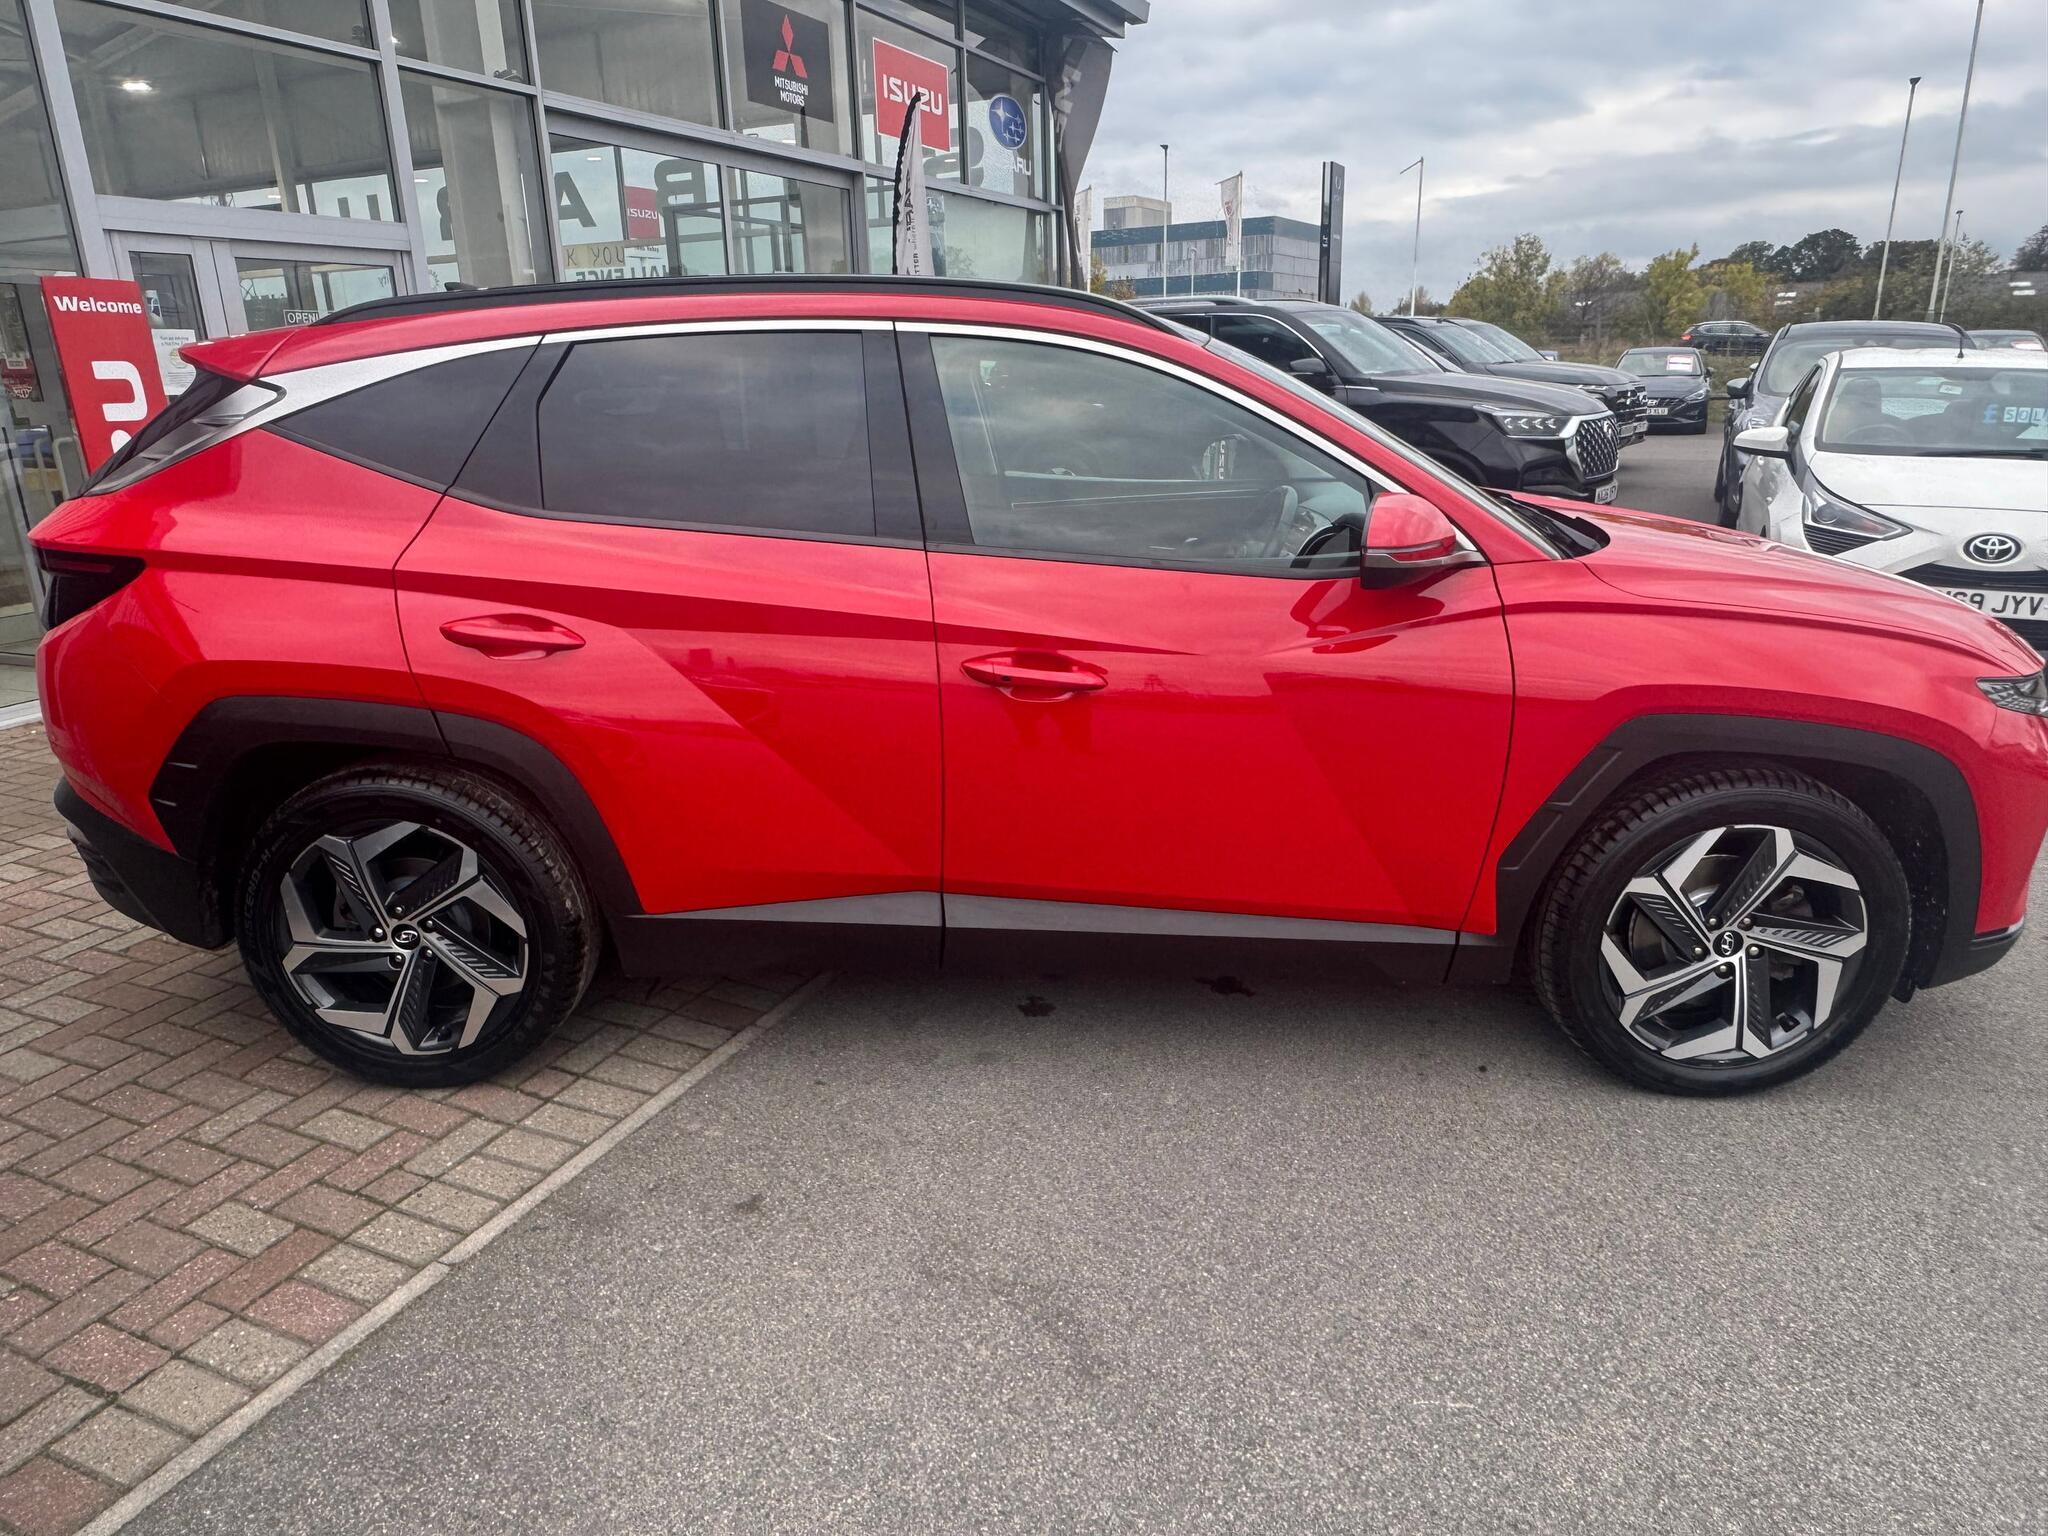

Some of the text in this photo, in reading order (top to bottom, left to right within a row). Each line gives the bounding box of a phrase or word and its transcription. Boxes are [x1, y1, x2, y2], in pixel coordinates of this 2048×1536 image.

[774, 75, 809, 96] MITSUBISHI
[883, 74, 943, 116] ISUZU
[780, 90, 805, 107] MOTORS
[627, 207, 658, 220] ISUZU
[52, 295, 143, 315] Welcome
[1991, 595, 2044, 616] JYV
